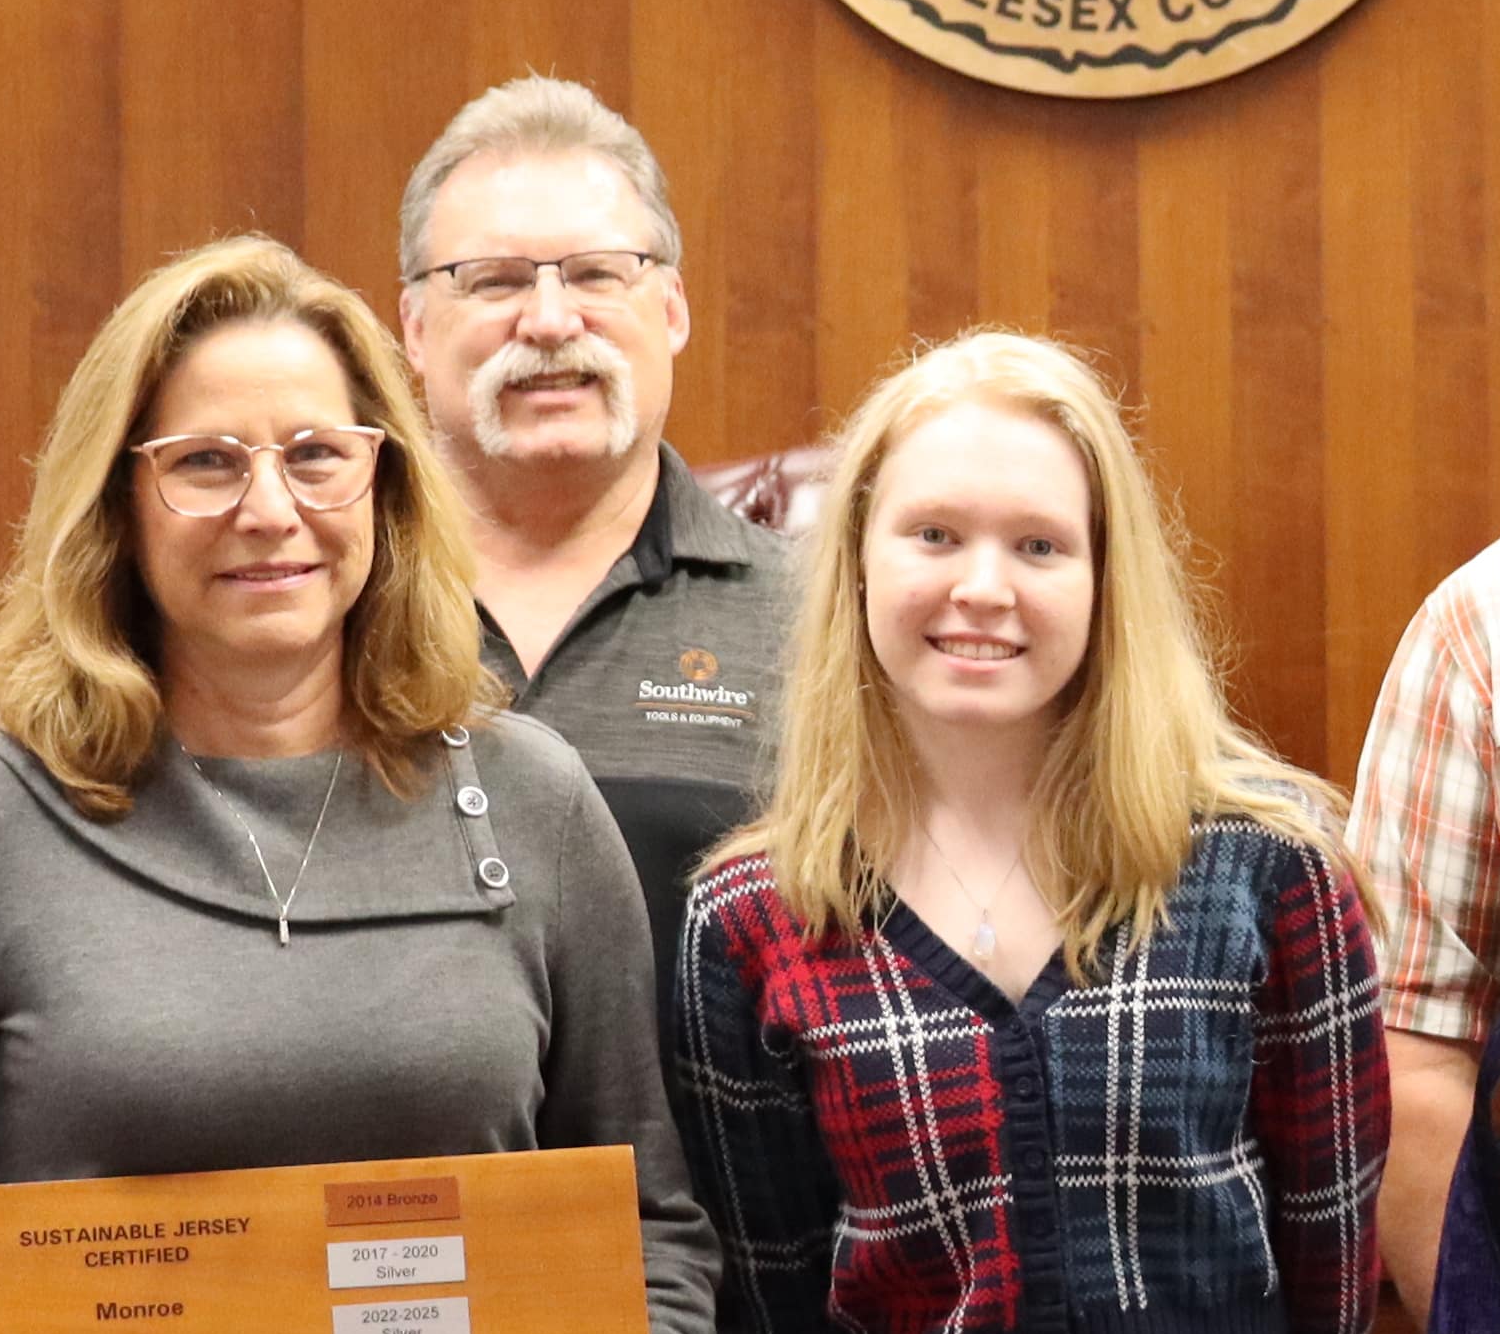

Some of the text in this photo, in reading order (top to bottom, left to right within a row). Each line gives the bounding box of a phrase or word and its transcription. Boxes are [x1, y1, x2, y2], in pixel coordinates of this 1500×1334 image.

[638, 679, 748, 705] Southwire
[645, 711, 679, 723] TOOLS
[688, 712, 743, 729] EQUIPMENT
[346, 1192, 438, 1209] 2014 Bronze
[19, 1217, 251, 1247] SUSTAINABLE JERSEY
[84, 1246, 190, 1268] CERTIFIED
[351, 1246, 388, 1262] 2017
[402, 1244, 439, 1259] 2020
[376, 1265, 417, 1280] Silver
[95, 1300, 184, 1321] Monroe
[361, 1305, 440, 1324] 2022-2025
